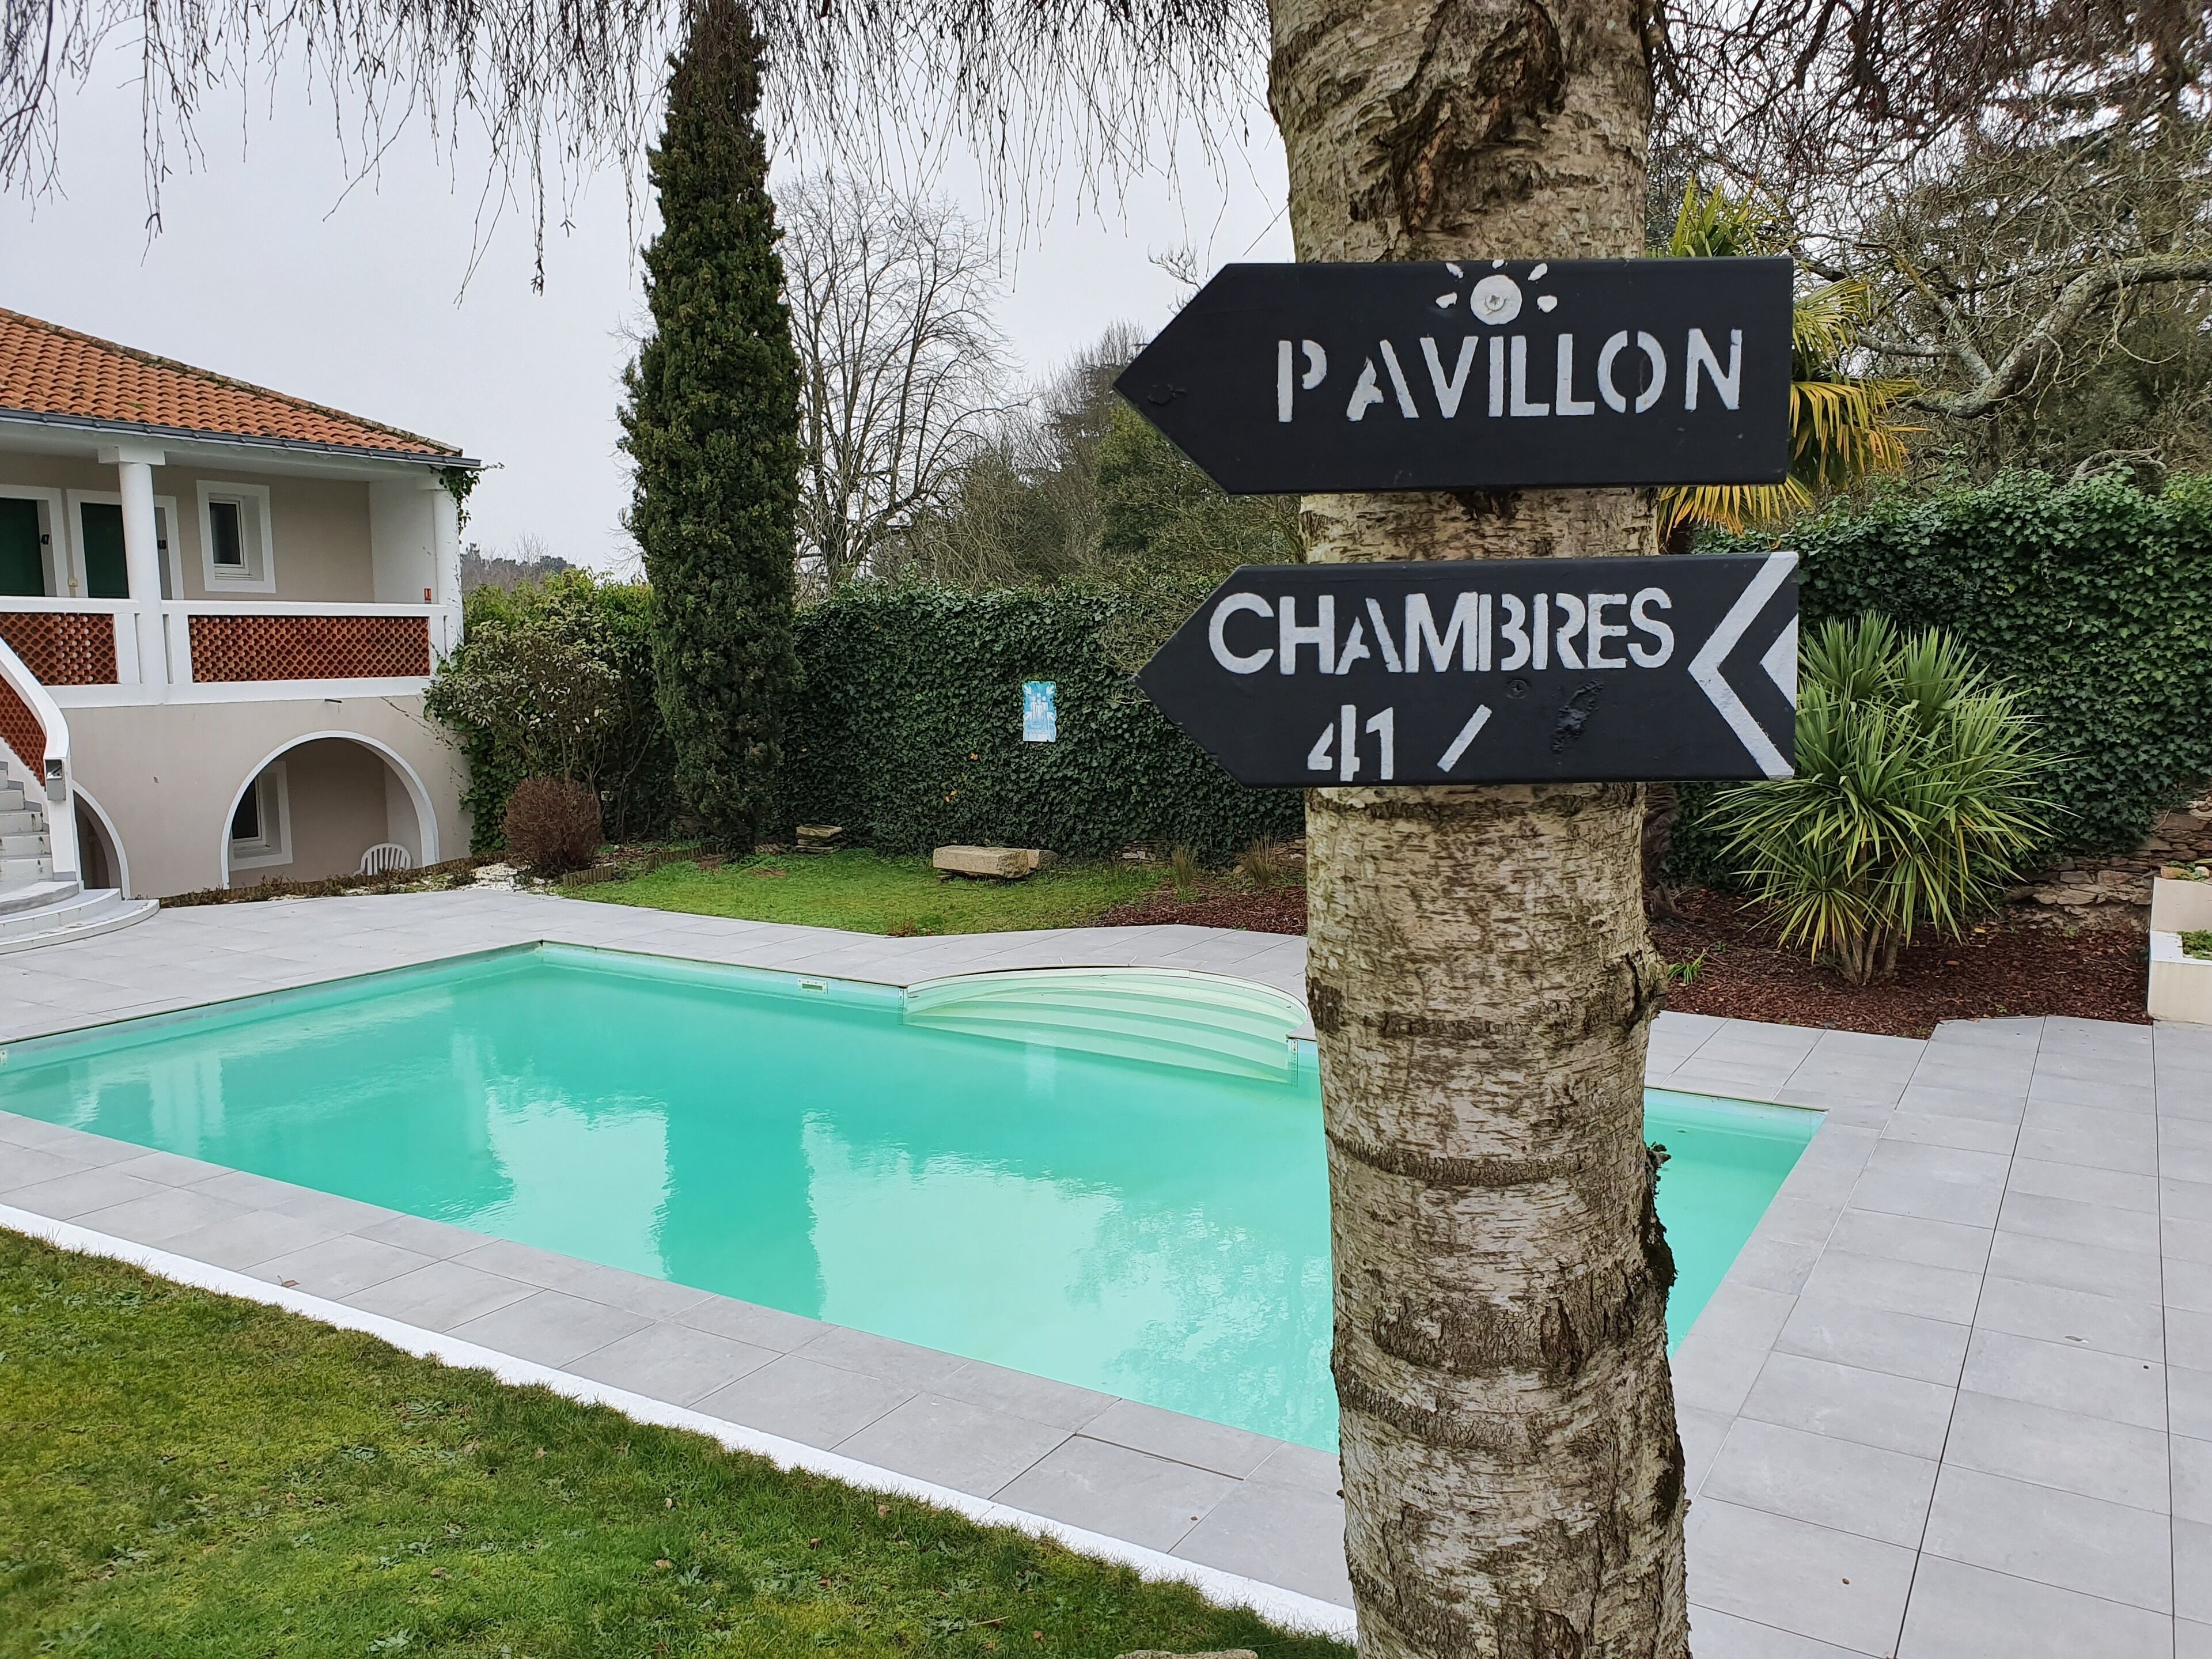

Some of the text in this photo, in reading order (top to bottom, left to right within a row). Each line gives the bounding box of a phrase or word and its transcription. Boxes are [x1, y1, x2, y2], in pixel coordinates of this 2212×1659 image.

[1277, 328, 1743, 422] PAVILLON
[1208, 586, 1675, 675] CHAMBRES
[1307, 704, 1393, 782] 41
